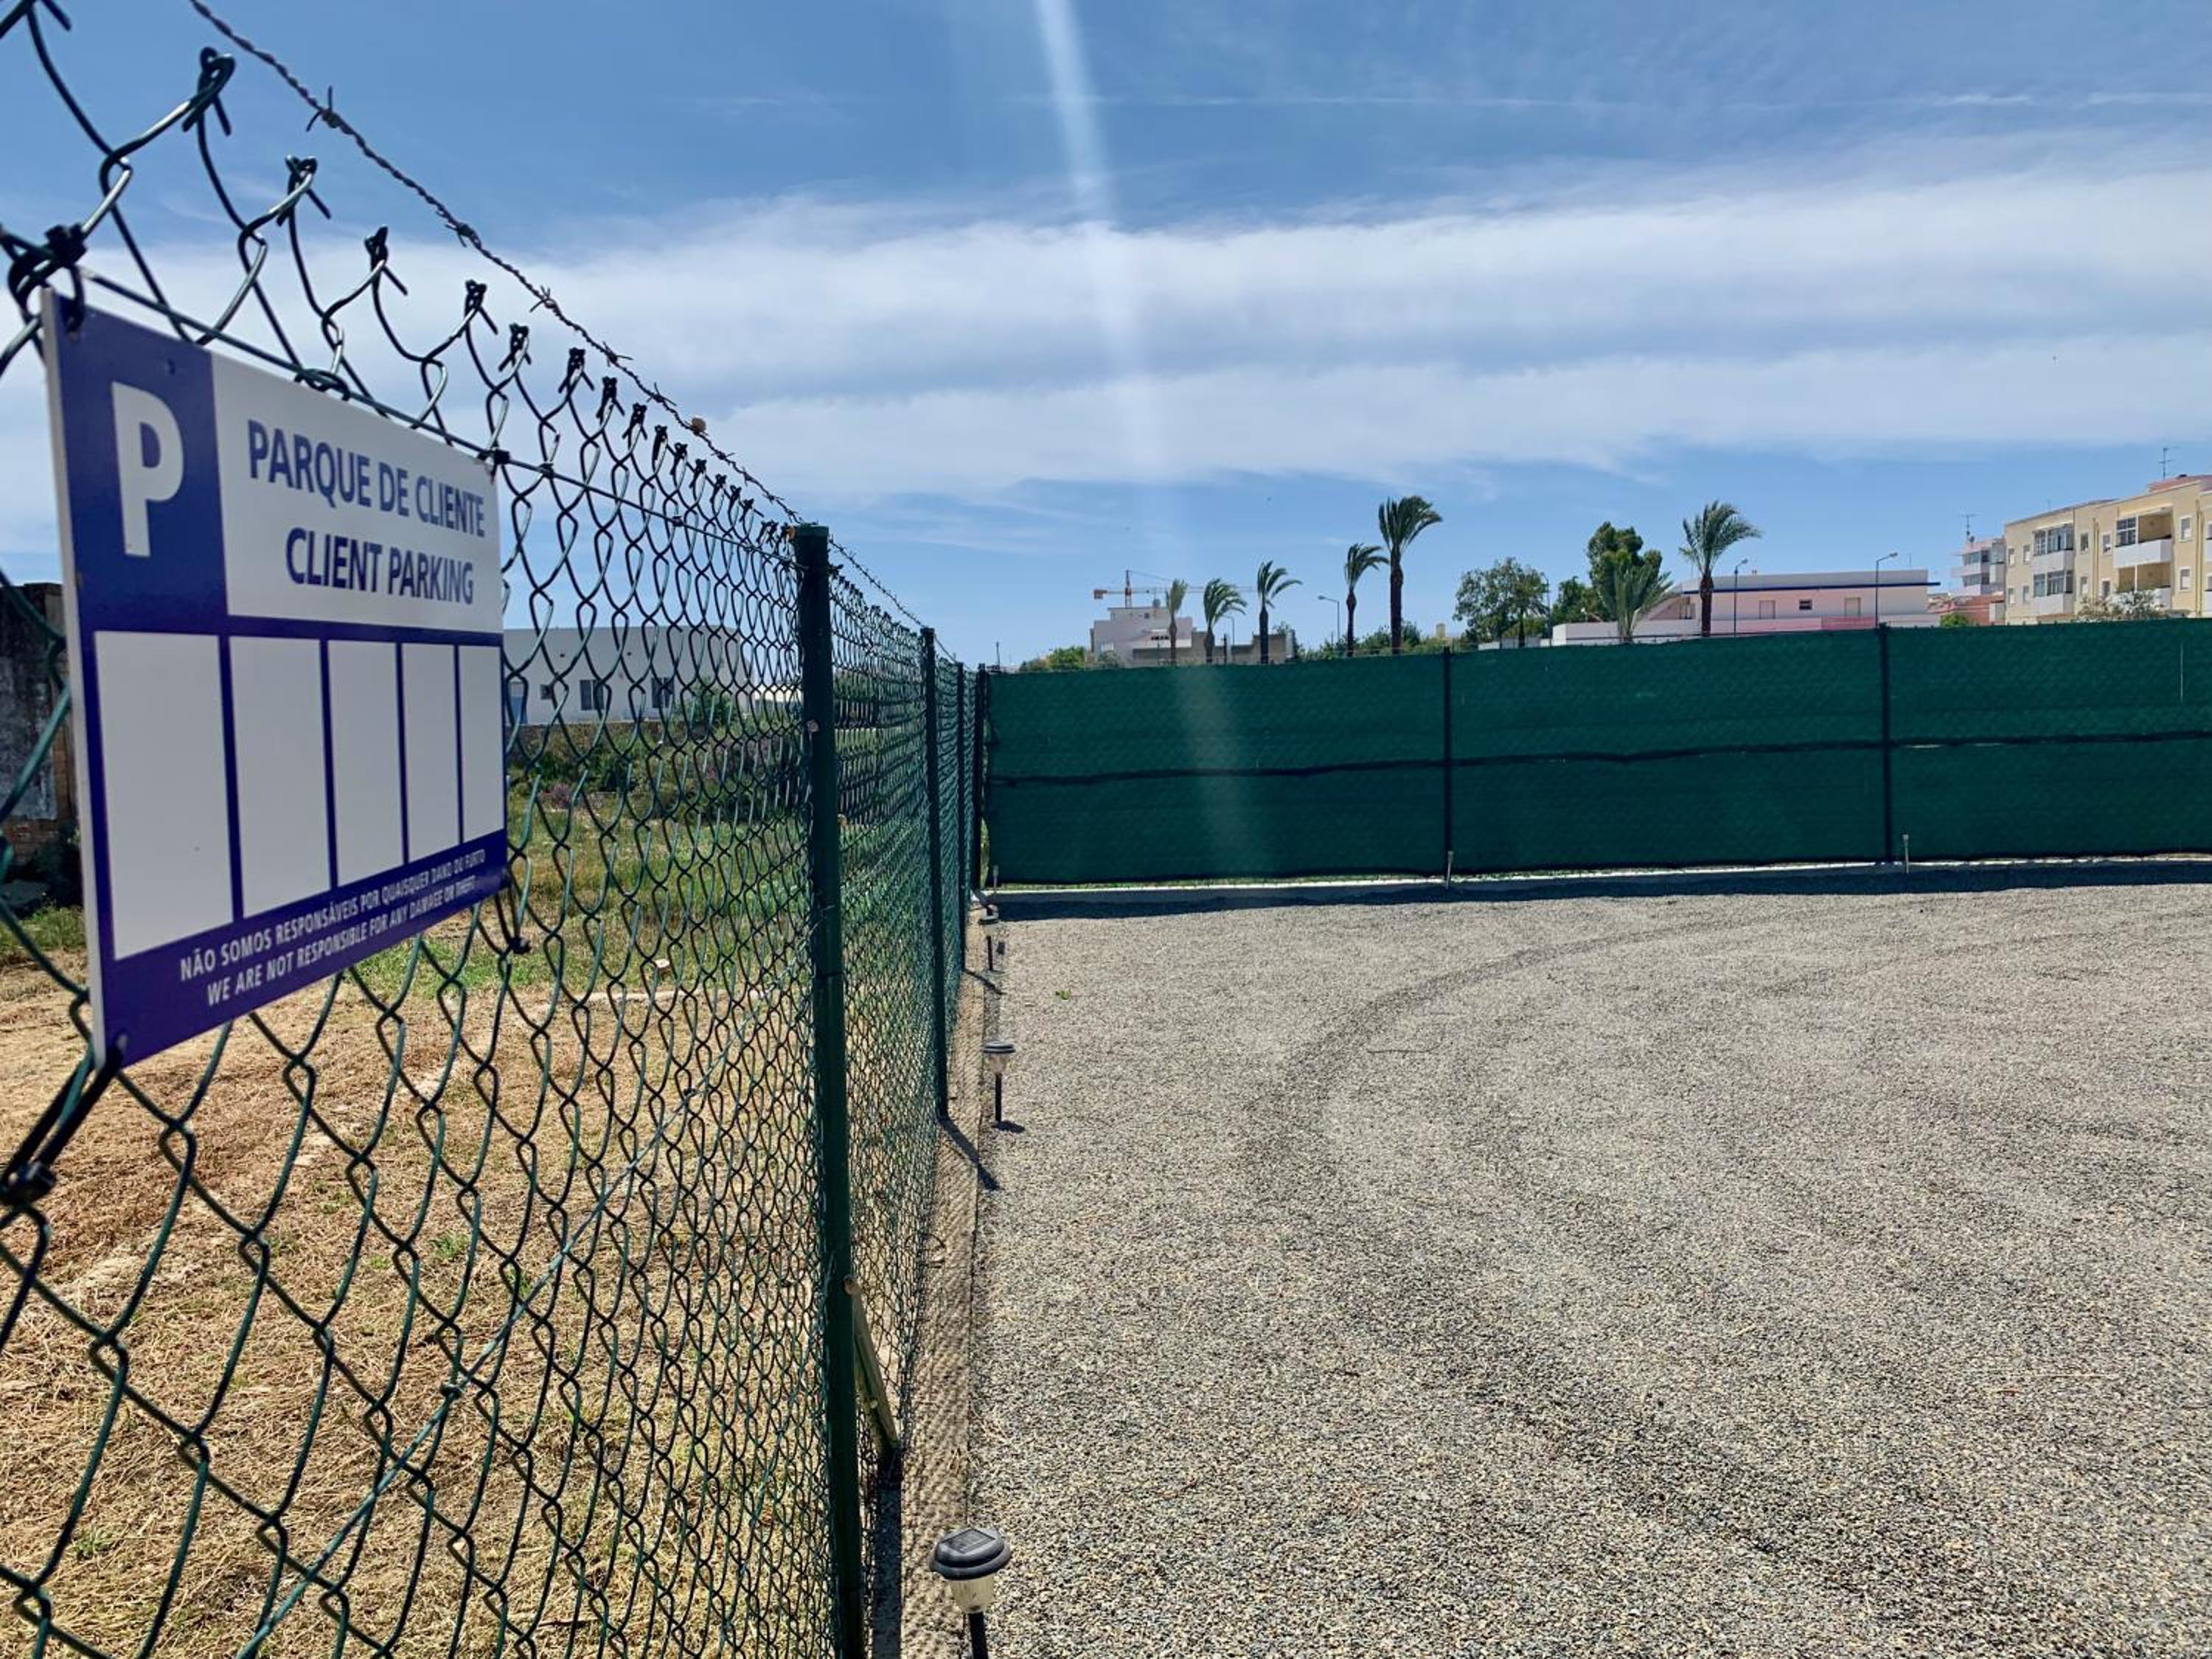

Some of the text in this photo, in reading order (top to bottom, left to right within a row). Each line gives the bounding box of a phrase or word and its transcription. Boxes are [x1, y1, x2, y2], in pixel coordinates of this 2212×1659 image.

[111, 381, 184, 558] P
[247, 419, 486, 538] PARQUE DE CLIENTE
[285, 526, 474, 605] CLIENT PARKING
[180, 947, 216, 982] NÃO
[220, 928, 273, 967] SOMOS
[275, 900, 359, 945] RESPONSÁVEIS
[360, 889, 380, 913] POR
[206, 975, 232, 1007] WE
[234, 963, 263, 995] ARE
[266, 950, 294, 982] NOT
[296, 922, 368, 969] RESPONSIBLE
[369, 914, 389, 937] FOR
[389, 905, 408, 928] ANY
